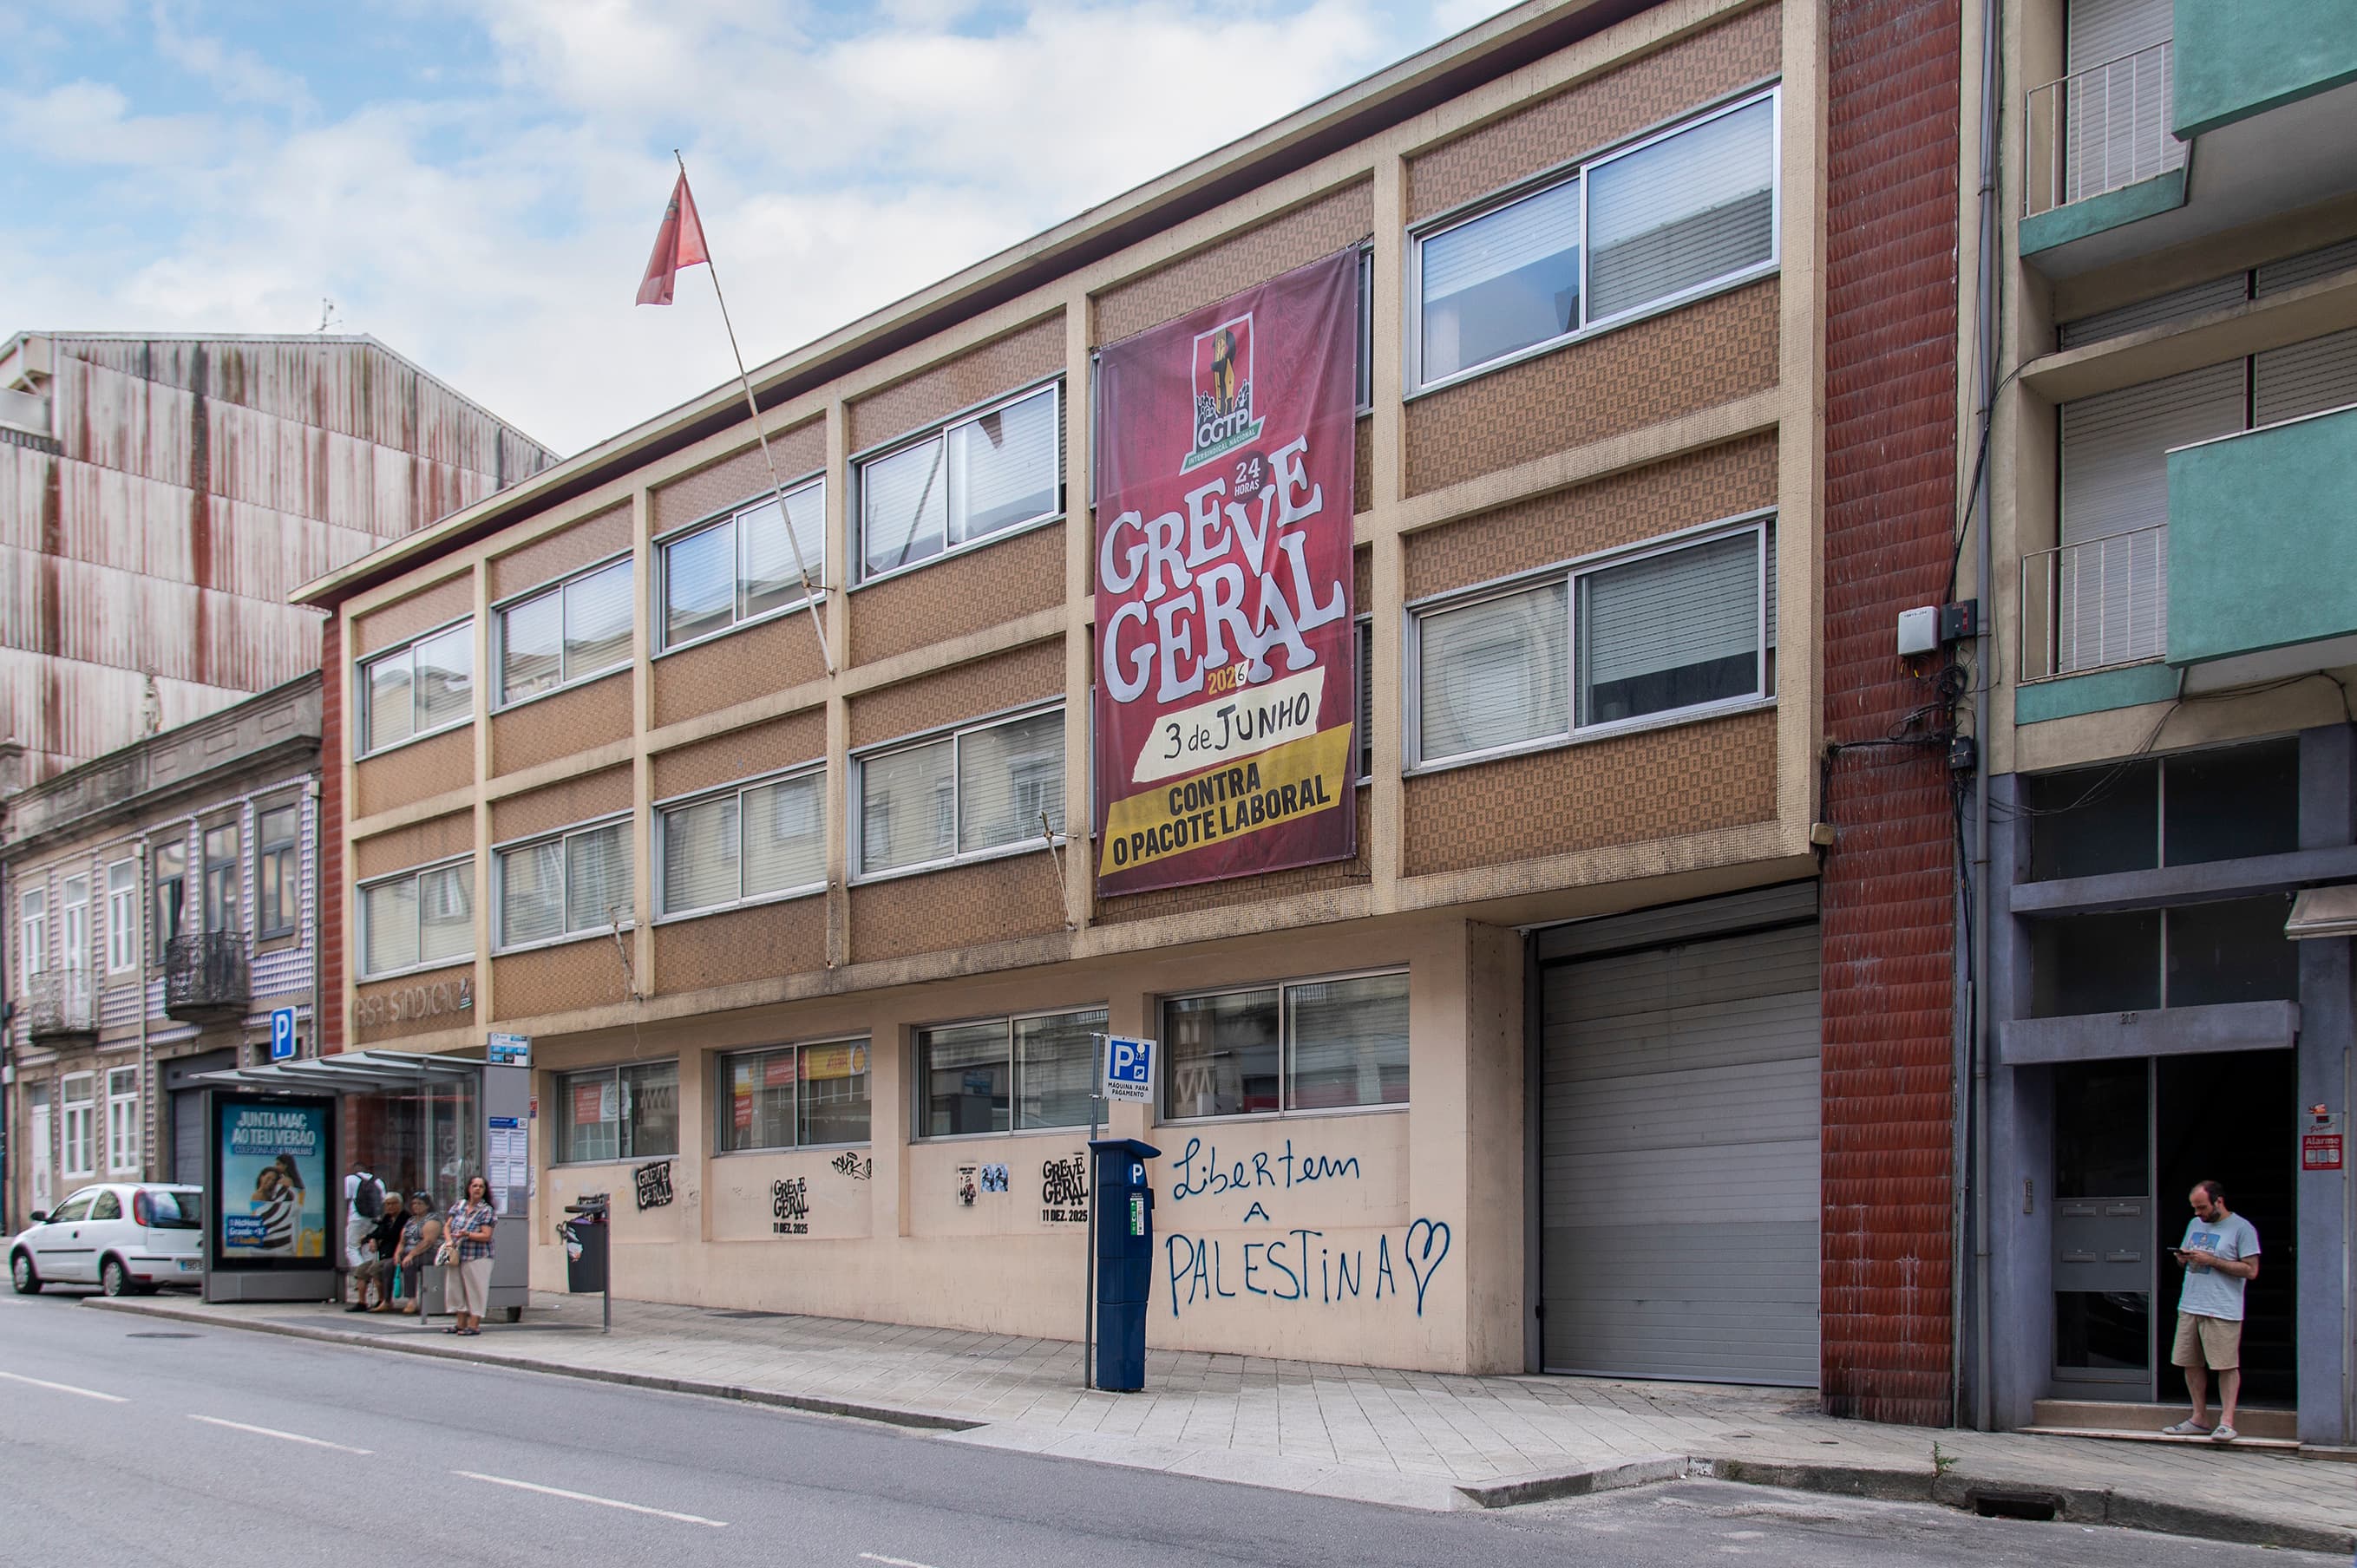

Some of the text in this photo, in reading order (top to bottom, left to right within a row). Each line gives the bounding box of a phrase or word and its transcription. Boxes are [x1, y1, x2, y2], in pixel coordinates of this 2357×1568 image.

[1198, 408, 1249, 448] CGTP
[1228, 428, 1256, 447] NACIONAL
[1234, 457, 1261, 484] 24
[1234, 479, 1260, 497] HORAS
[1100, 434, 1324, 603] GREVE
[1103, 530, 1346, 704] GERAL
[1208, 663, 1247, 696] 2026
[1164, 692, 1311, 760] 3 de JUNHO
[1169, 761, 1261, 817] CONTRA
[1112, 774, 1331, 866] O PACOTE LABORAL
[275, 1014, 290, 1054] P
[1114, 1044, 1135, 1077] P
[1111, 1088, 1144, 1098] PAGAMENTO
[236, 1111, 278, 1127] JUNTA
[232, 1127, 316, 1146] AO TEU VERÃO
[2305, 1136, 2340, 1146] Alarme
[1042, 1156, 1085, 1183] GREVE
[1132, 1163, 1143, 1184] P
[774, 1176, 807, 1198] GREVE
[1042, 1176, 1089, 1206] GERAL
[773, 1193, 809, 1220] GERAL
[1042, 1209, 1088, 1223] 11 DEZ. 2025
[1243, 1201, 1270, 1223] A
[793, 1223, 809, 1234] 2025
